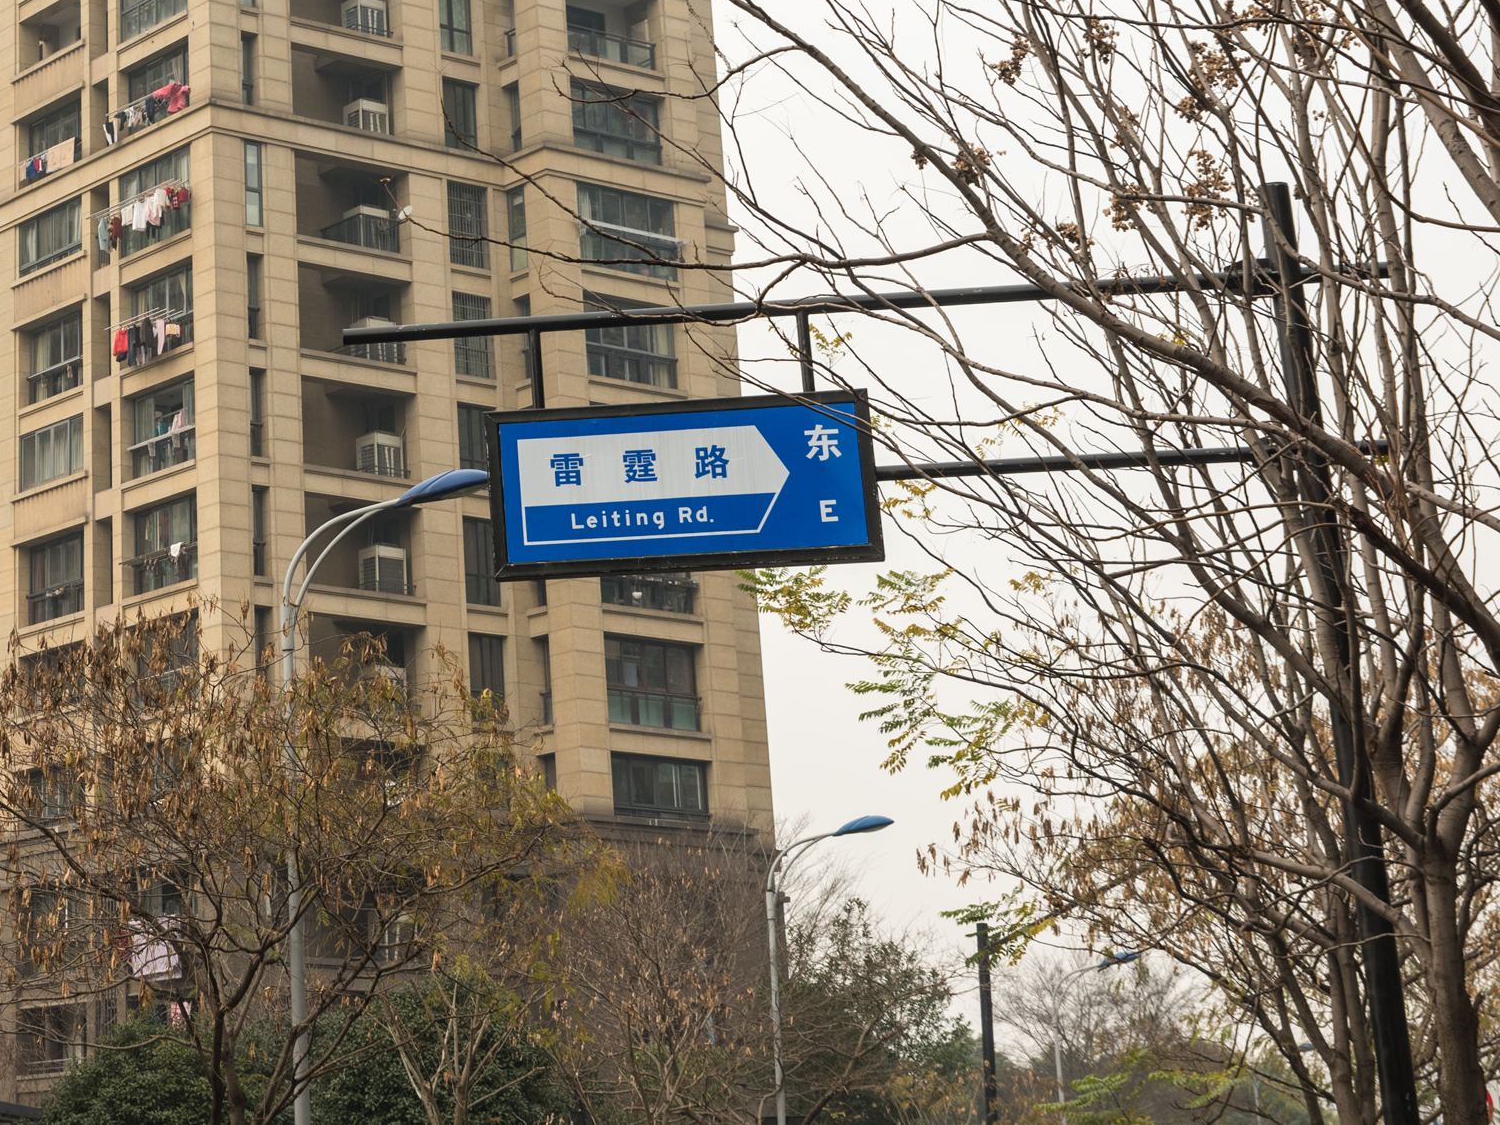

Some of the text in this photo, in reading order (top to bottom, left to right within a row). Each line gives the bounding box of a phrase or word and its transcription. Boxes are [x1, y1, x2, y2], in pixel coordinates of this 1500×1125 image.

[803, 424, 842, 462] 东
[549, 444, 730, 487] 雷霆路
[570, 505, 715, 530] Leiting Rd.
[819, 499, 839, 523] E
